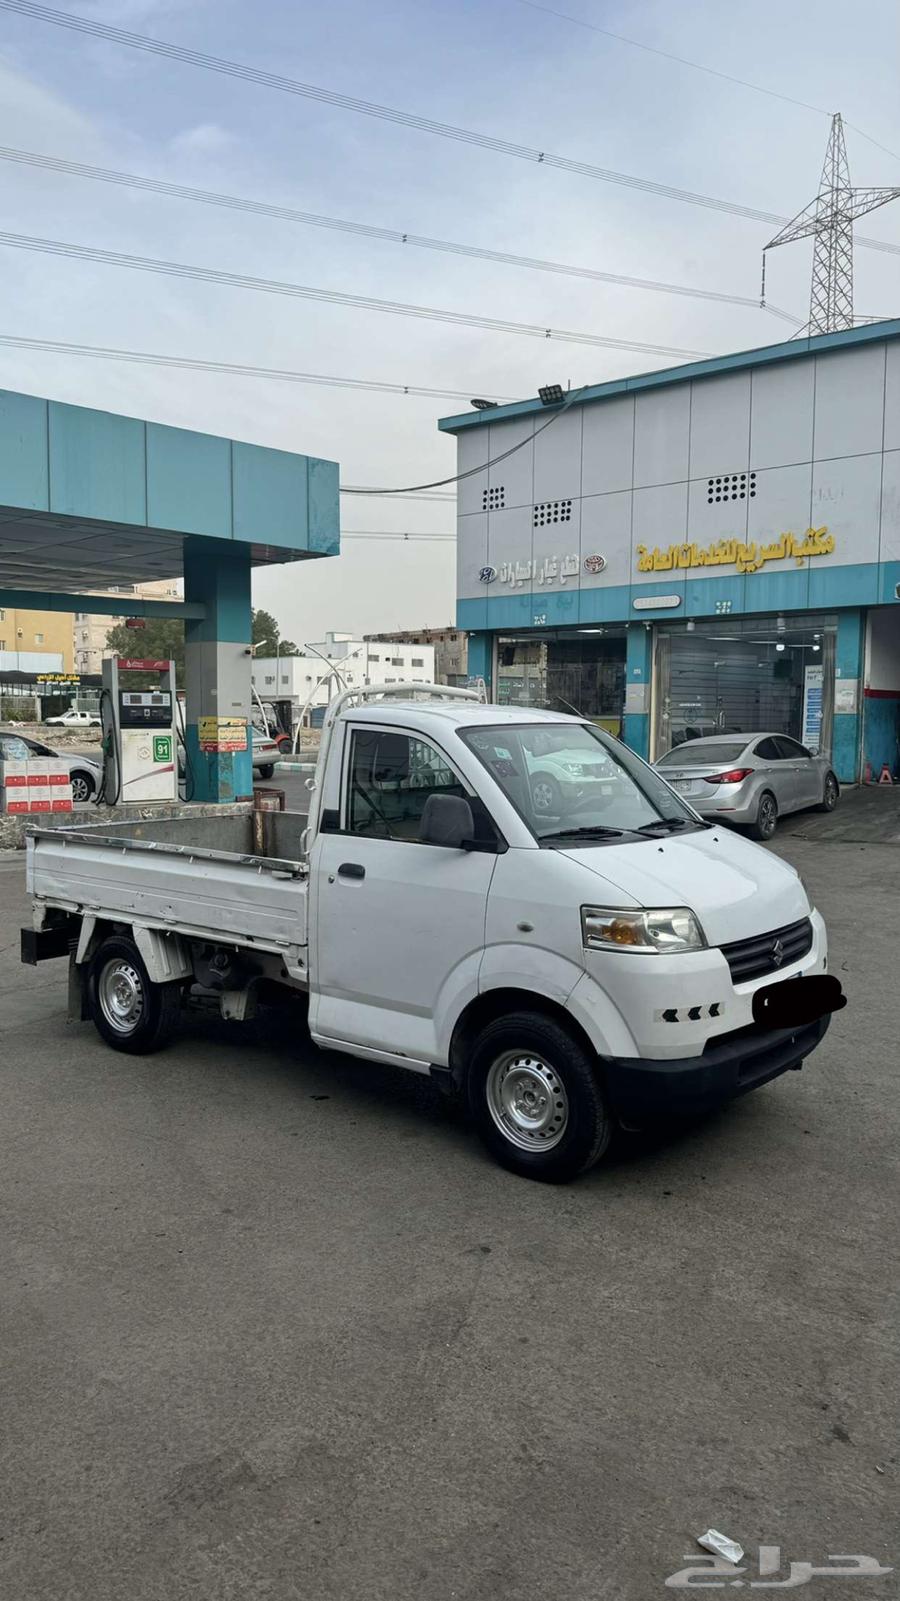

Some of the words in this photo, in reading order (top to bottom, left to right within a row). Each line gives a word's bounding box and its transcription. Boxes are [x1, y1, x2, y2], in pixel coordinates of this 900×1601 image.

[636, 543, 679, 571] العامة
[677, 537, 739, 568] للخدمات
[735, 531, 793, 573] السريع
[791, 526, 835, 566] مكتب
[500, 560, 537, 588] السيارات
[538, 555, 557, 585] غيار
[560, 554, 579, 585] قطع
[157, 744, 168, 754] 91
